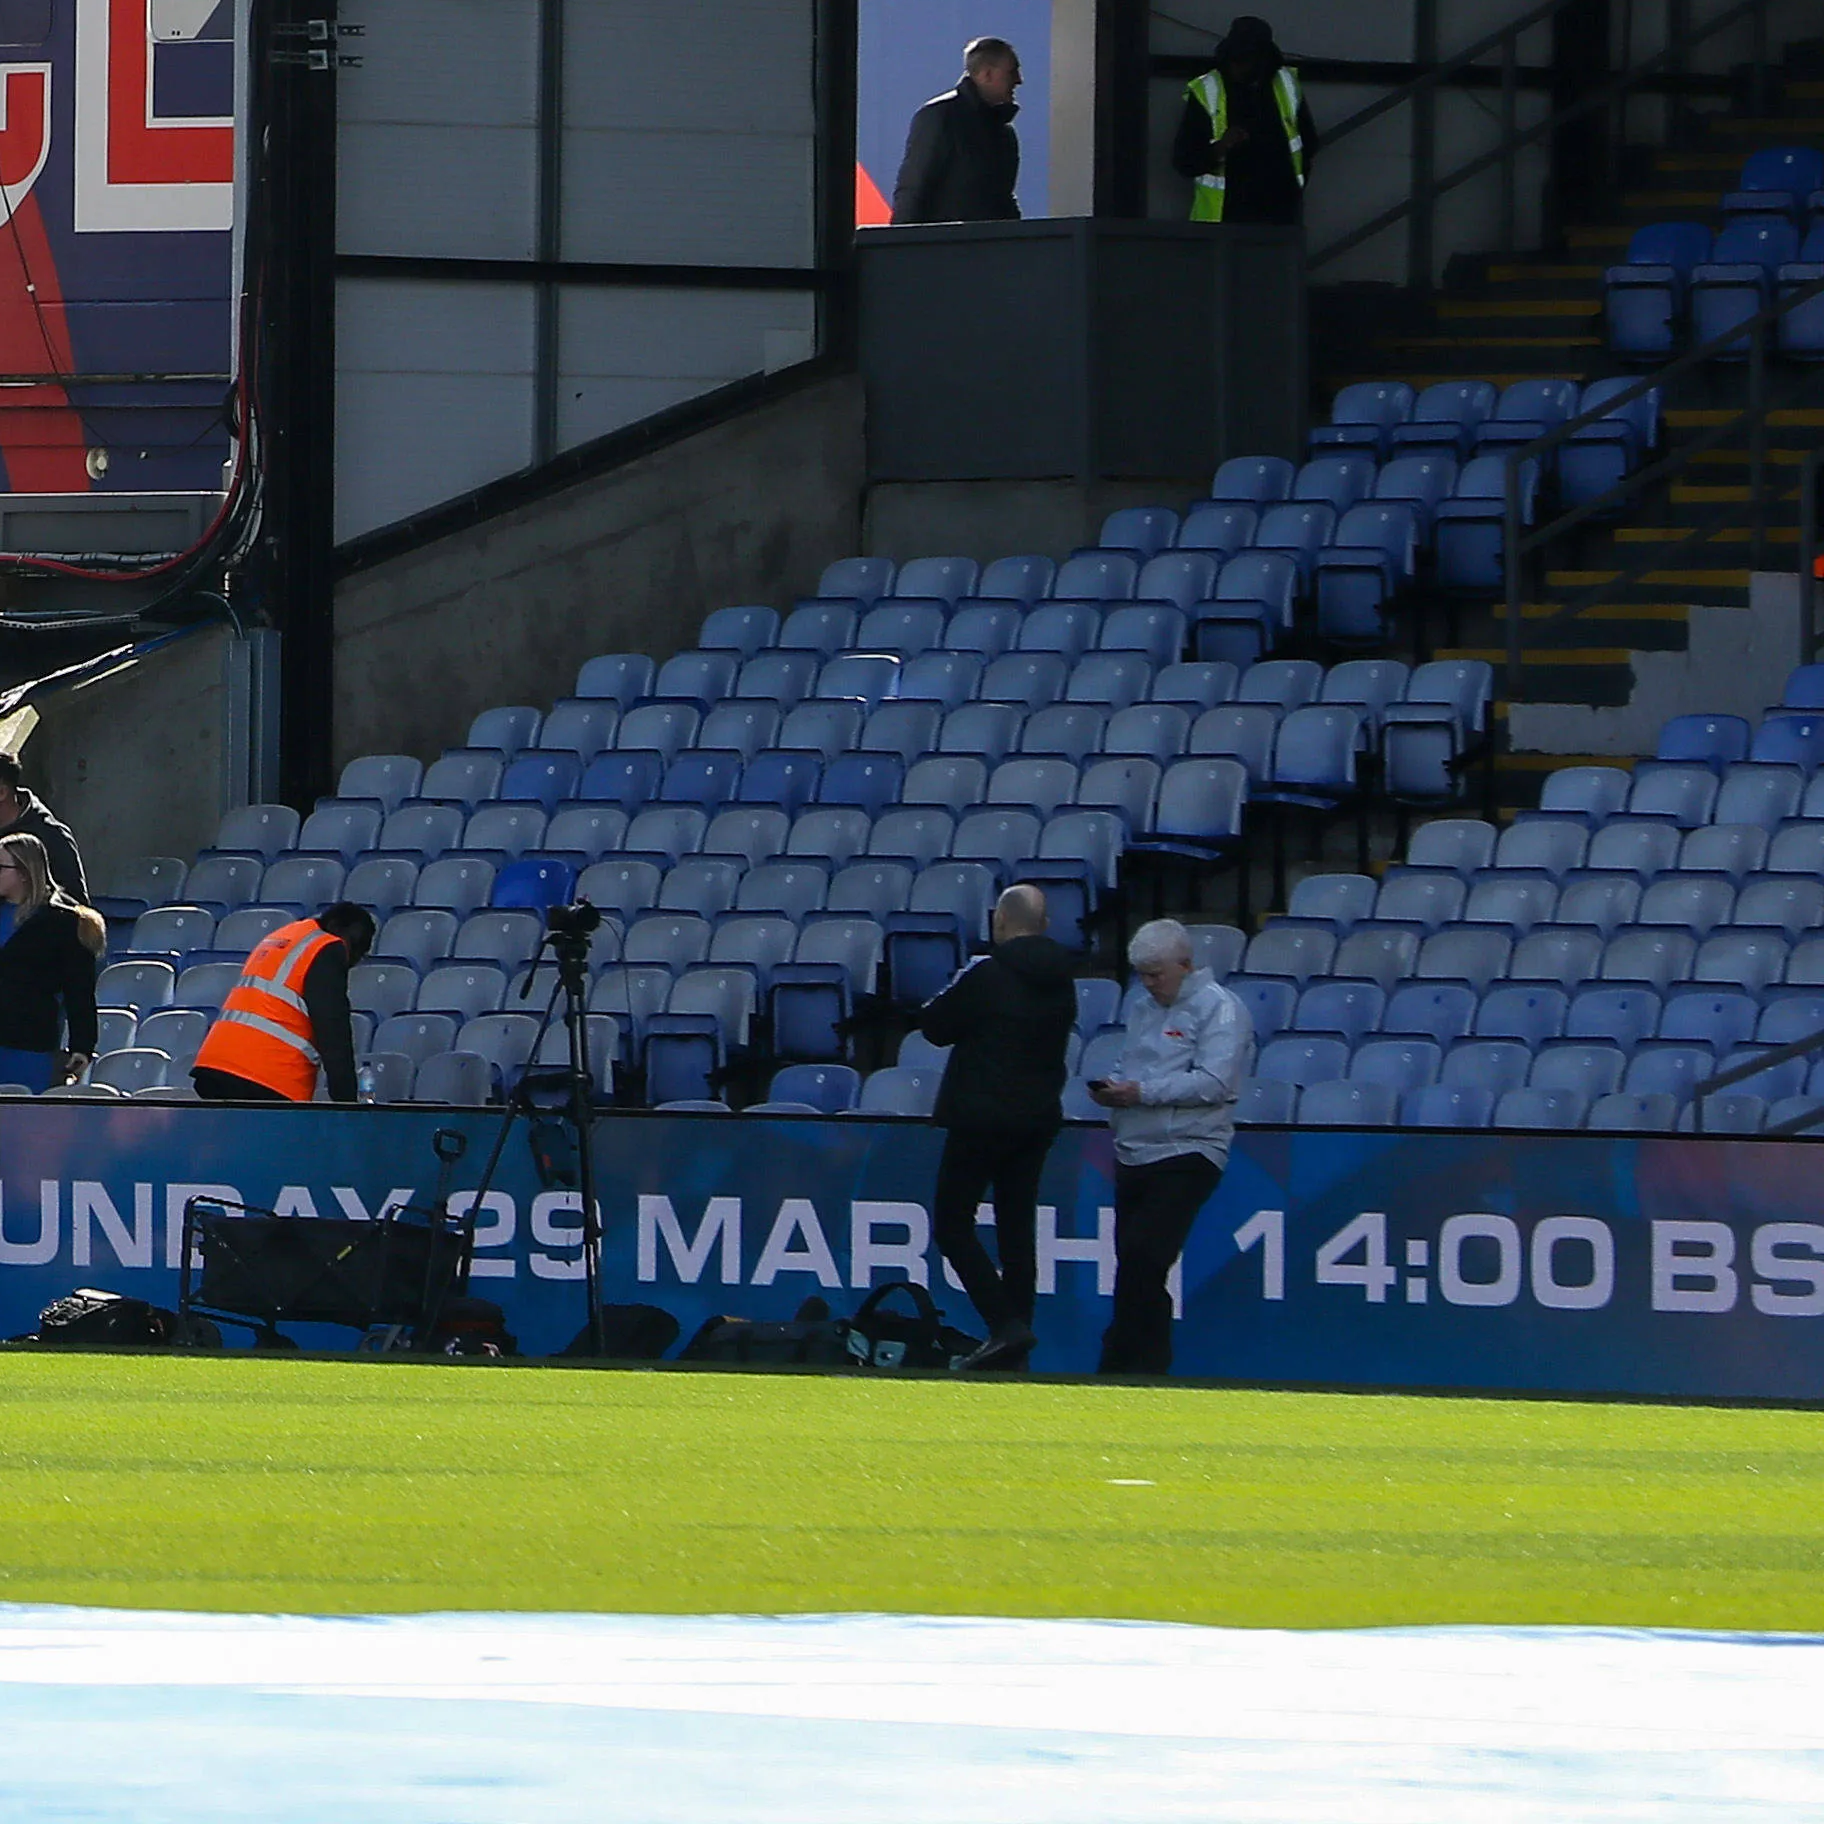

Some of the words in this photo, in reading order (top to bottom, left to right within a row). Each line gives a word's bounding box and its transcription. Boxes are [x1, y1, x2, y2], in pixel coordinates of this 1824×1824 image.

[637, 1194, 1117, 1296] MARH
[1233, 1210, 1615, 1310] 14:00
[1651, 1219, 1824, 1317] BS
